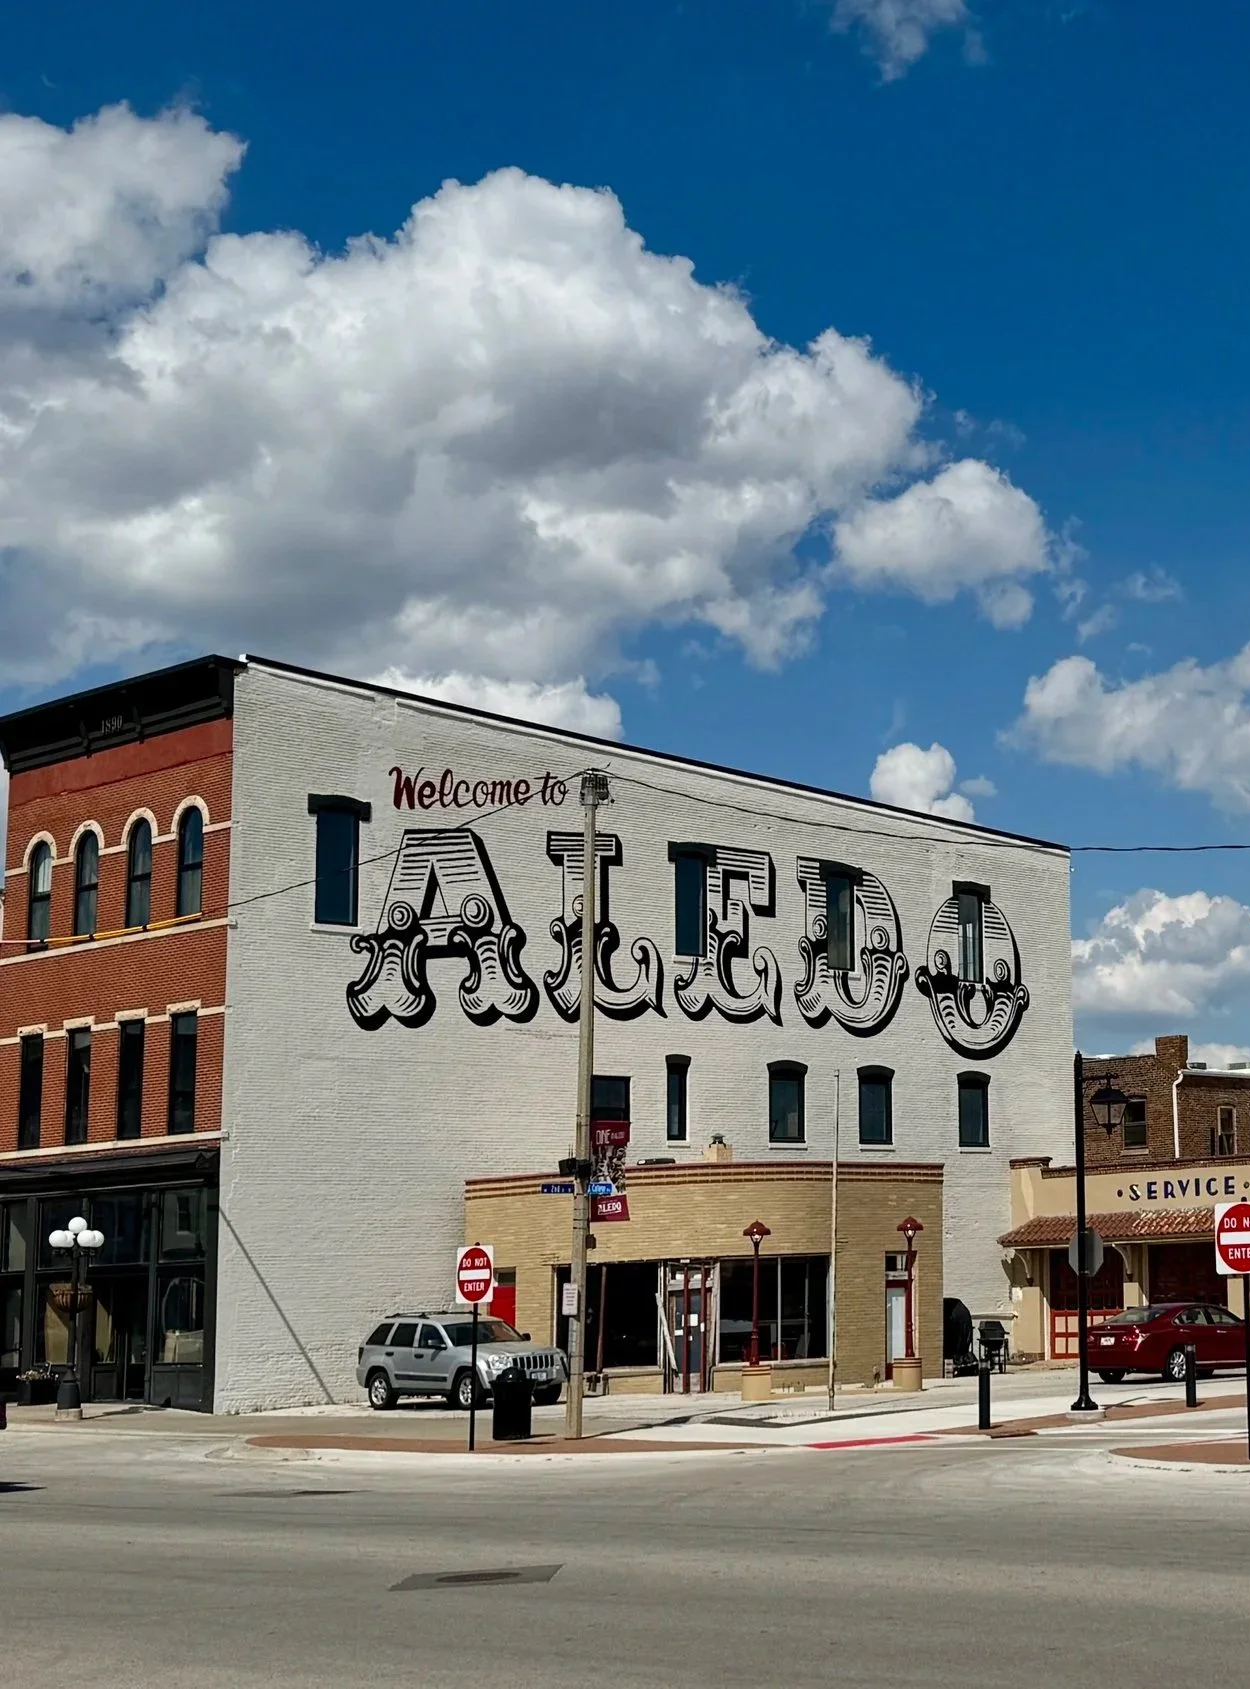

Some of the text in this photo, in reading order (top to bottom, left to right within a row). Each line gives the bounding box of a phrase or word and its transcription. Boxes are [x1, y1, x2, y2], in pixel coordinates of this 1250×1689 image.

[101, 715, 123, 735] 1890
[389, 766, 569, 810] Welcome to
[346, 828, 1030, 1060] ALEDO
[1128, 1175, 1236, 1201] SERVICE
[1224, 1217, 1237, 1229] DO
[462, 1256, 488, 1268] DO NOT
[463, 1281, 485, 1292] ENTER
